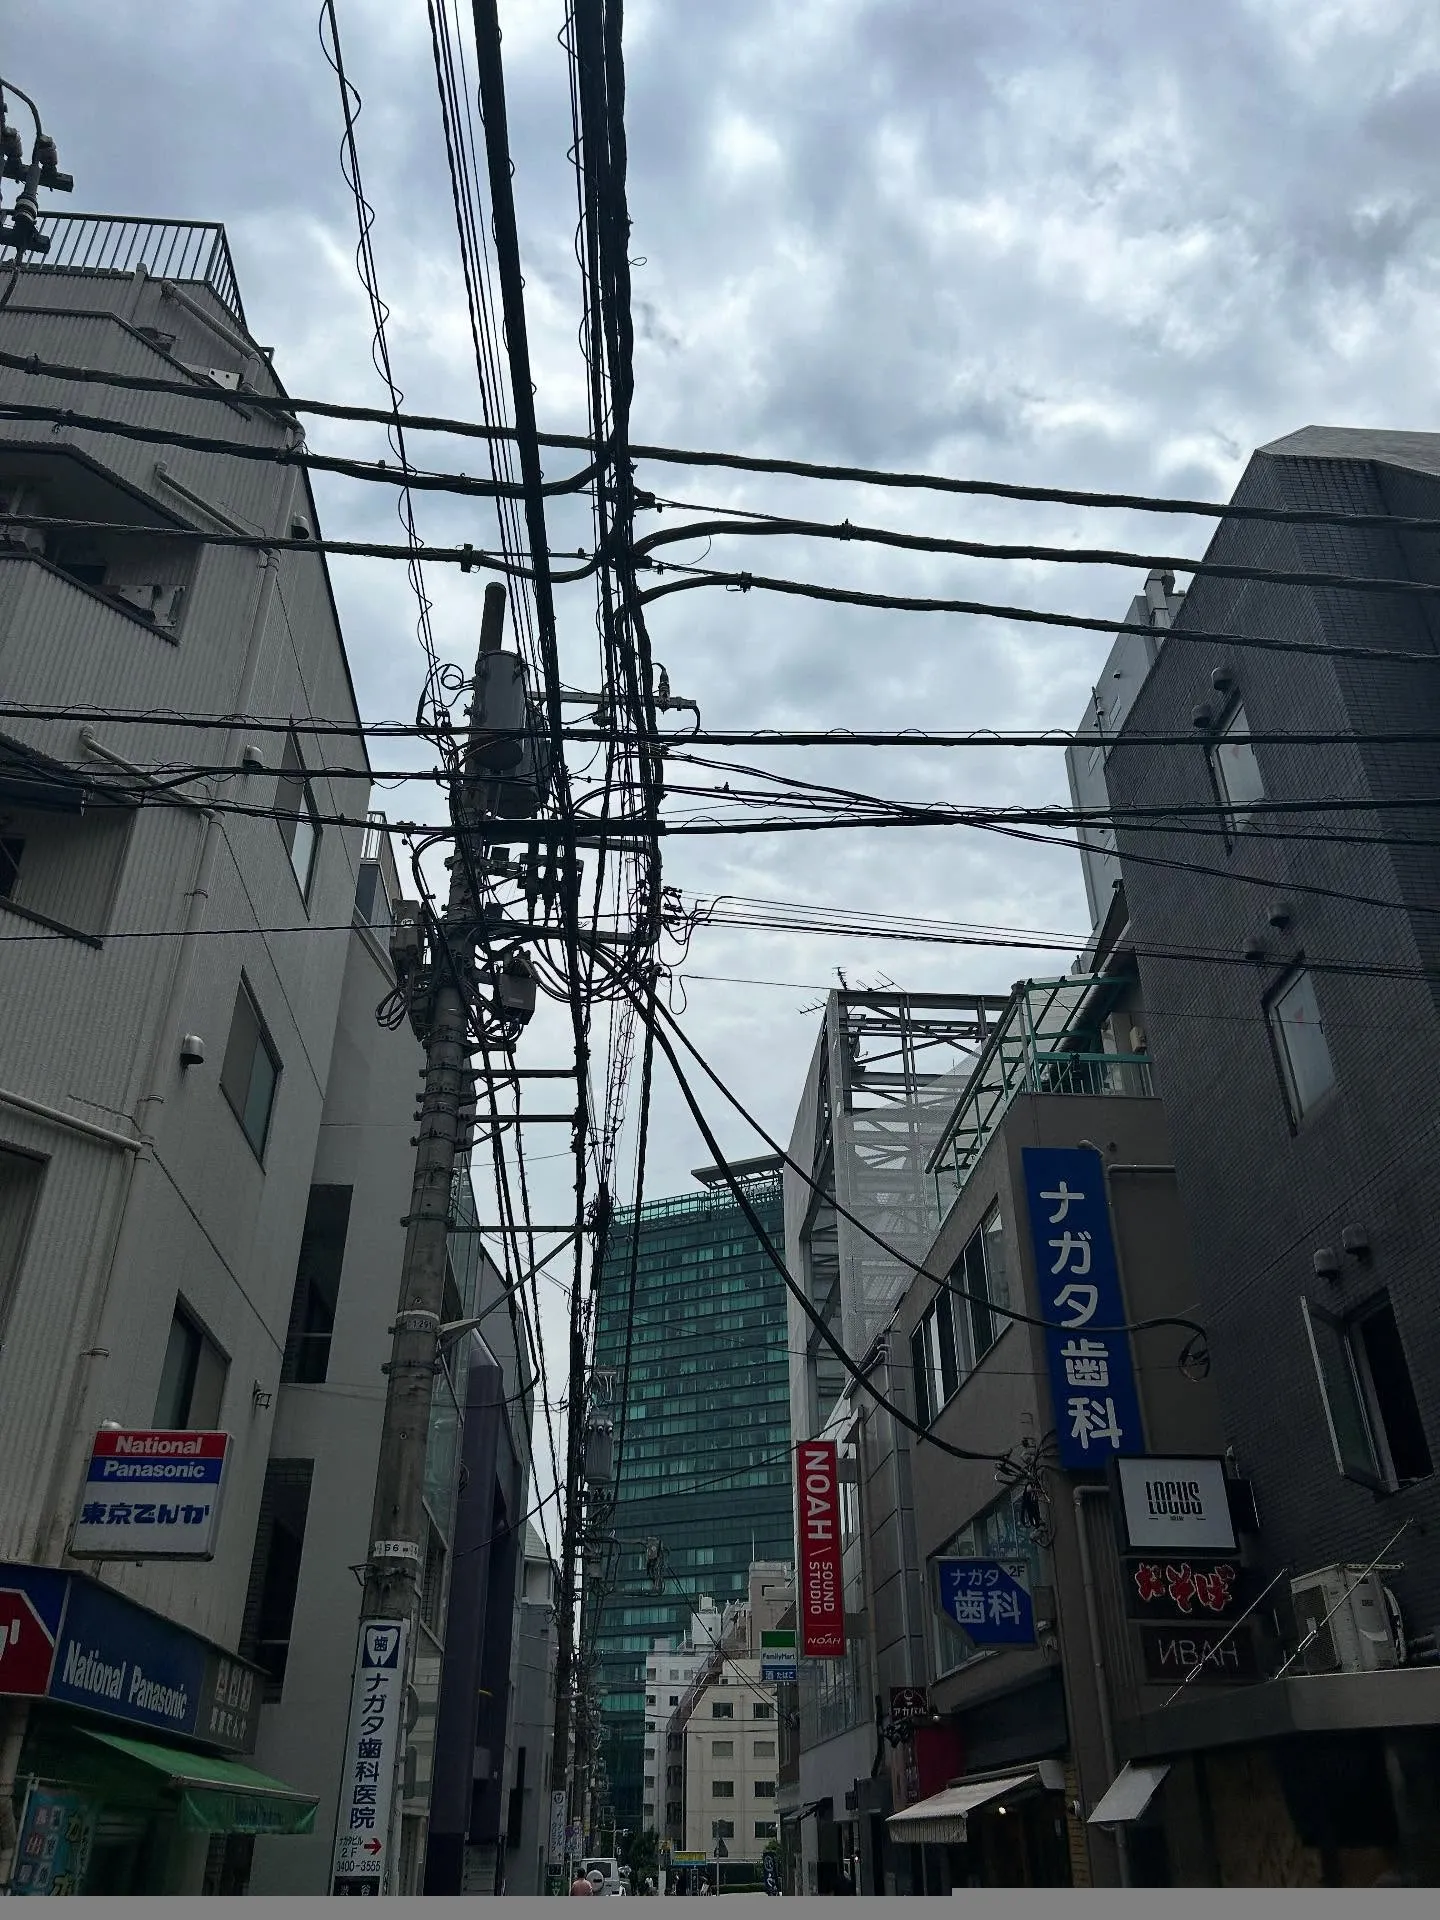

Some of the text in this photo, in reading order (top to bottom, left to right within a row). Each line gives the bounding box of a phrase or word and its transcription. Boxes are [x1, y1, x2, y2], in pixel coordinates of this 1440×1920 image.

[1039, 1181, 1123, 1450] ナガタ歯科
[115, 1435, 204, 1454] National
[103, 1460, 205, 1478] Panasonic
[805, 1450, 832, 1540] NOAH
[1145, 1480, 1203, 1515] LOCUS
[79, 1501, 210, 1525] 東京でんか
[950, 1568, 999, 1586] ナガタ
[1009, 1565, 1025, 1577] 2F
[809, 1561, 822, 1615] STUDIO
[822, 1562, 834, 1612] SOUND
[1134, 1561, 1236, 1613] おそば
[953, 1589, 1021, 1626] 歯科
[374, 1635, 388, 1652] 歯
[762, 1652, 795, 1661] FamilyMart
[62, 1639, 127, 1700] National
[128, 1664, 188, 1720] Panasonic
[776, 1671, 794, 1680] たばこ
[349, 1673, 389, 1829] ナガタ歯科医院
[336, 1860, 381, 1872] 3400-3555
